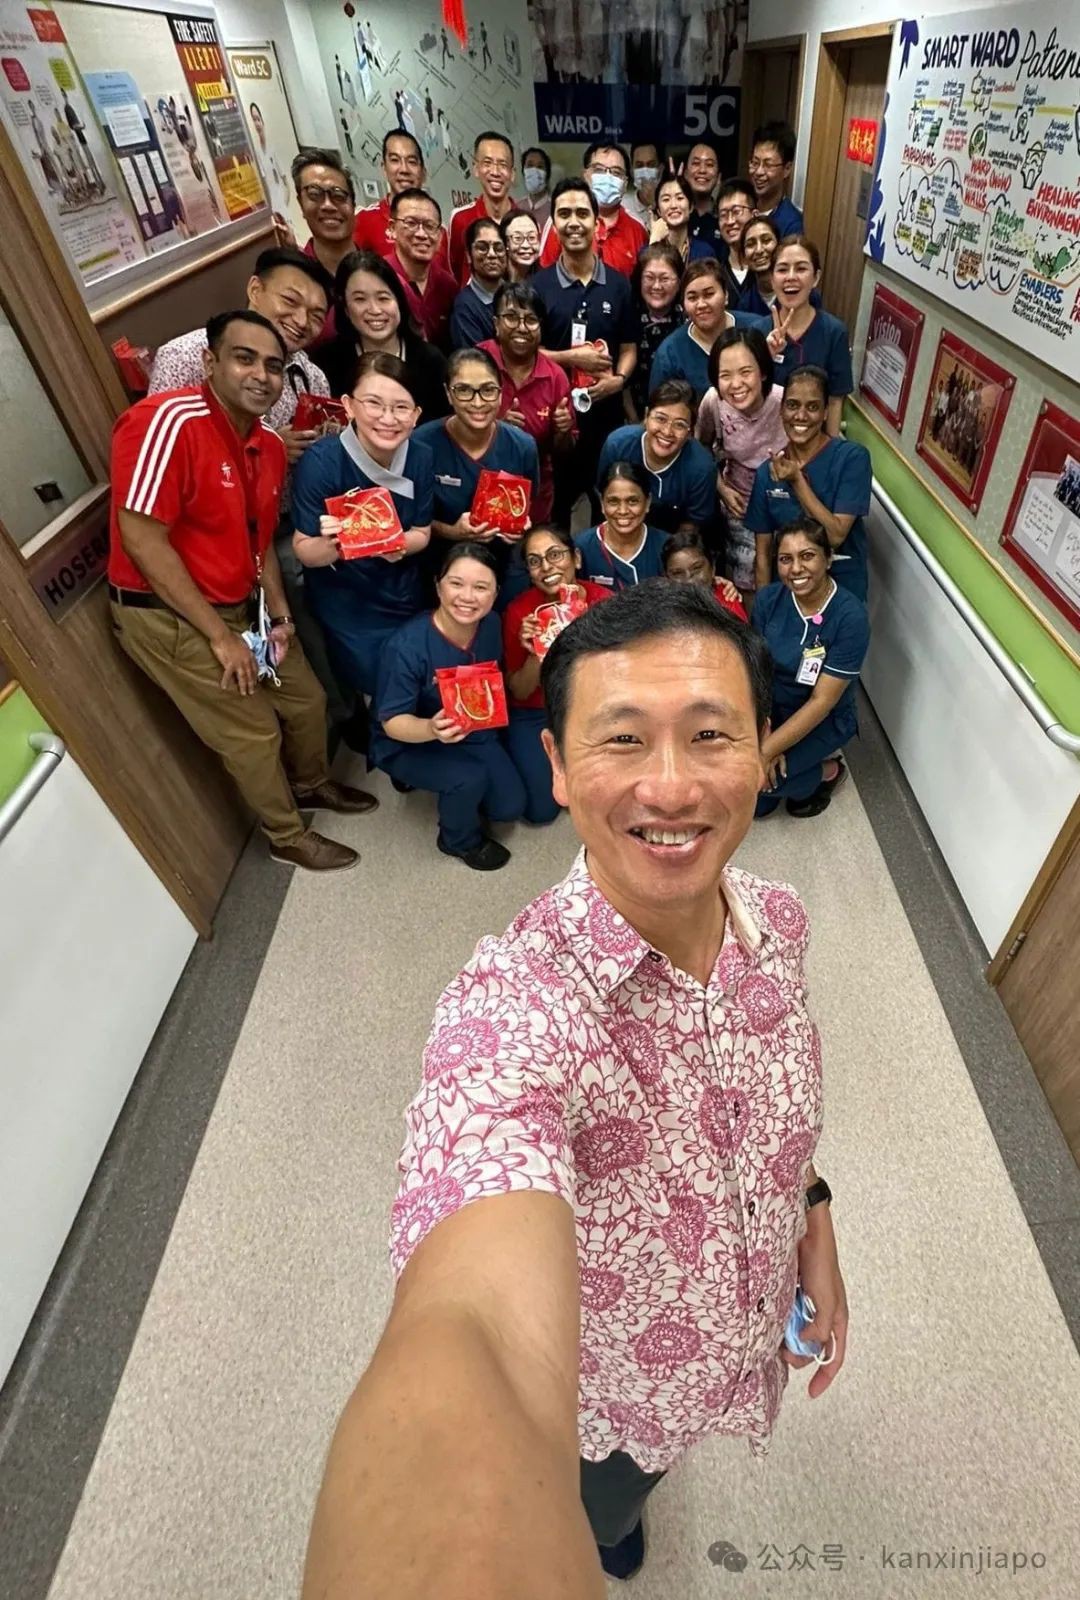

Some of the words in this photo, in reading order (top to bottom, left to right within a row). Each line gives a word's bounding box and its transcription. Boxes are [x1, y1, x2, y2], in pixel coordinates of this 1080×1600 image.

[172, 19, 193, 43] FIRE
[190, 20, 216, 43] SAFETY
[921, 34, 970, 70] SMART
[970, 28, 1020, 69] WARD
[234, 58, 257, 77] Ward
[256, 59, 269, 77] 5C
[545, 115, 602, 134] WARD
[683, 95, 736, 137] 5C
[1025, 198, 1080, 238] ENVIRONMEN
[1019, 273, 1064, 304] ENABLERS
[873, 315, 902, 345] vision
